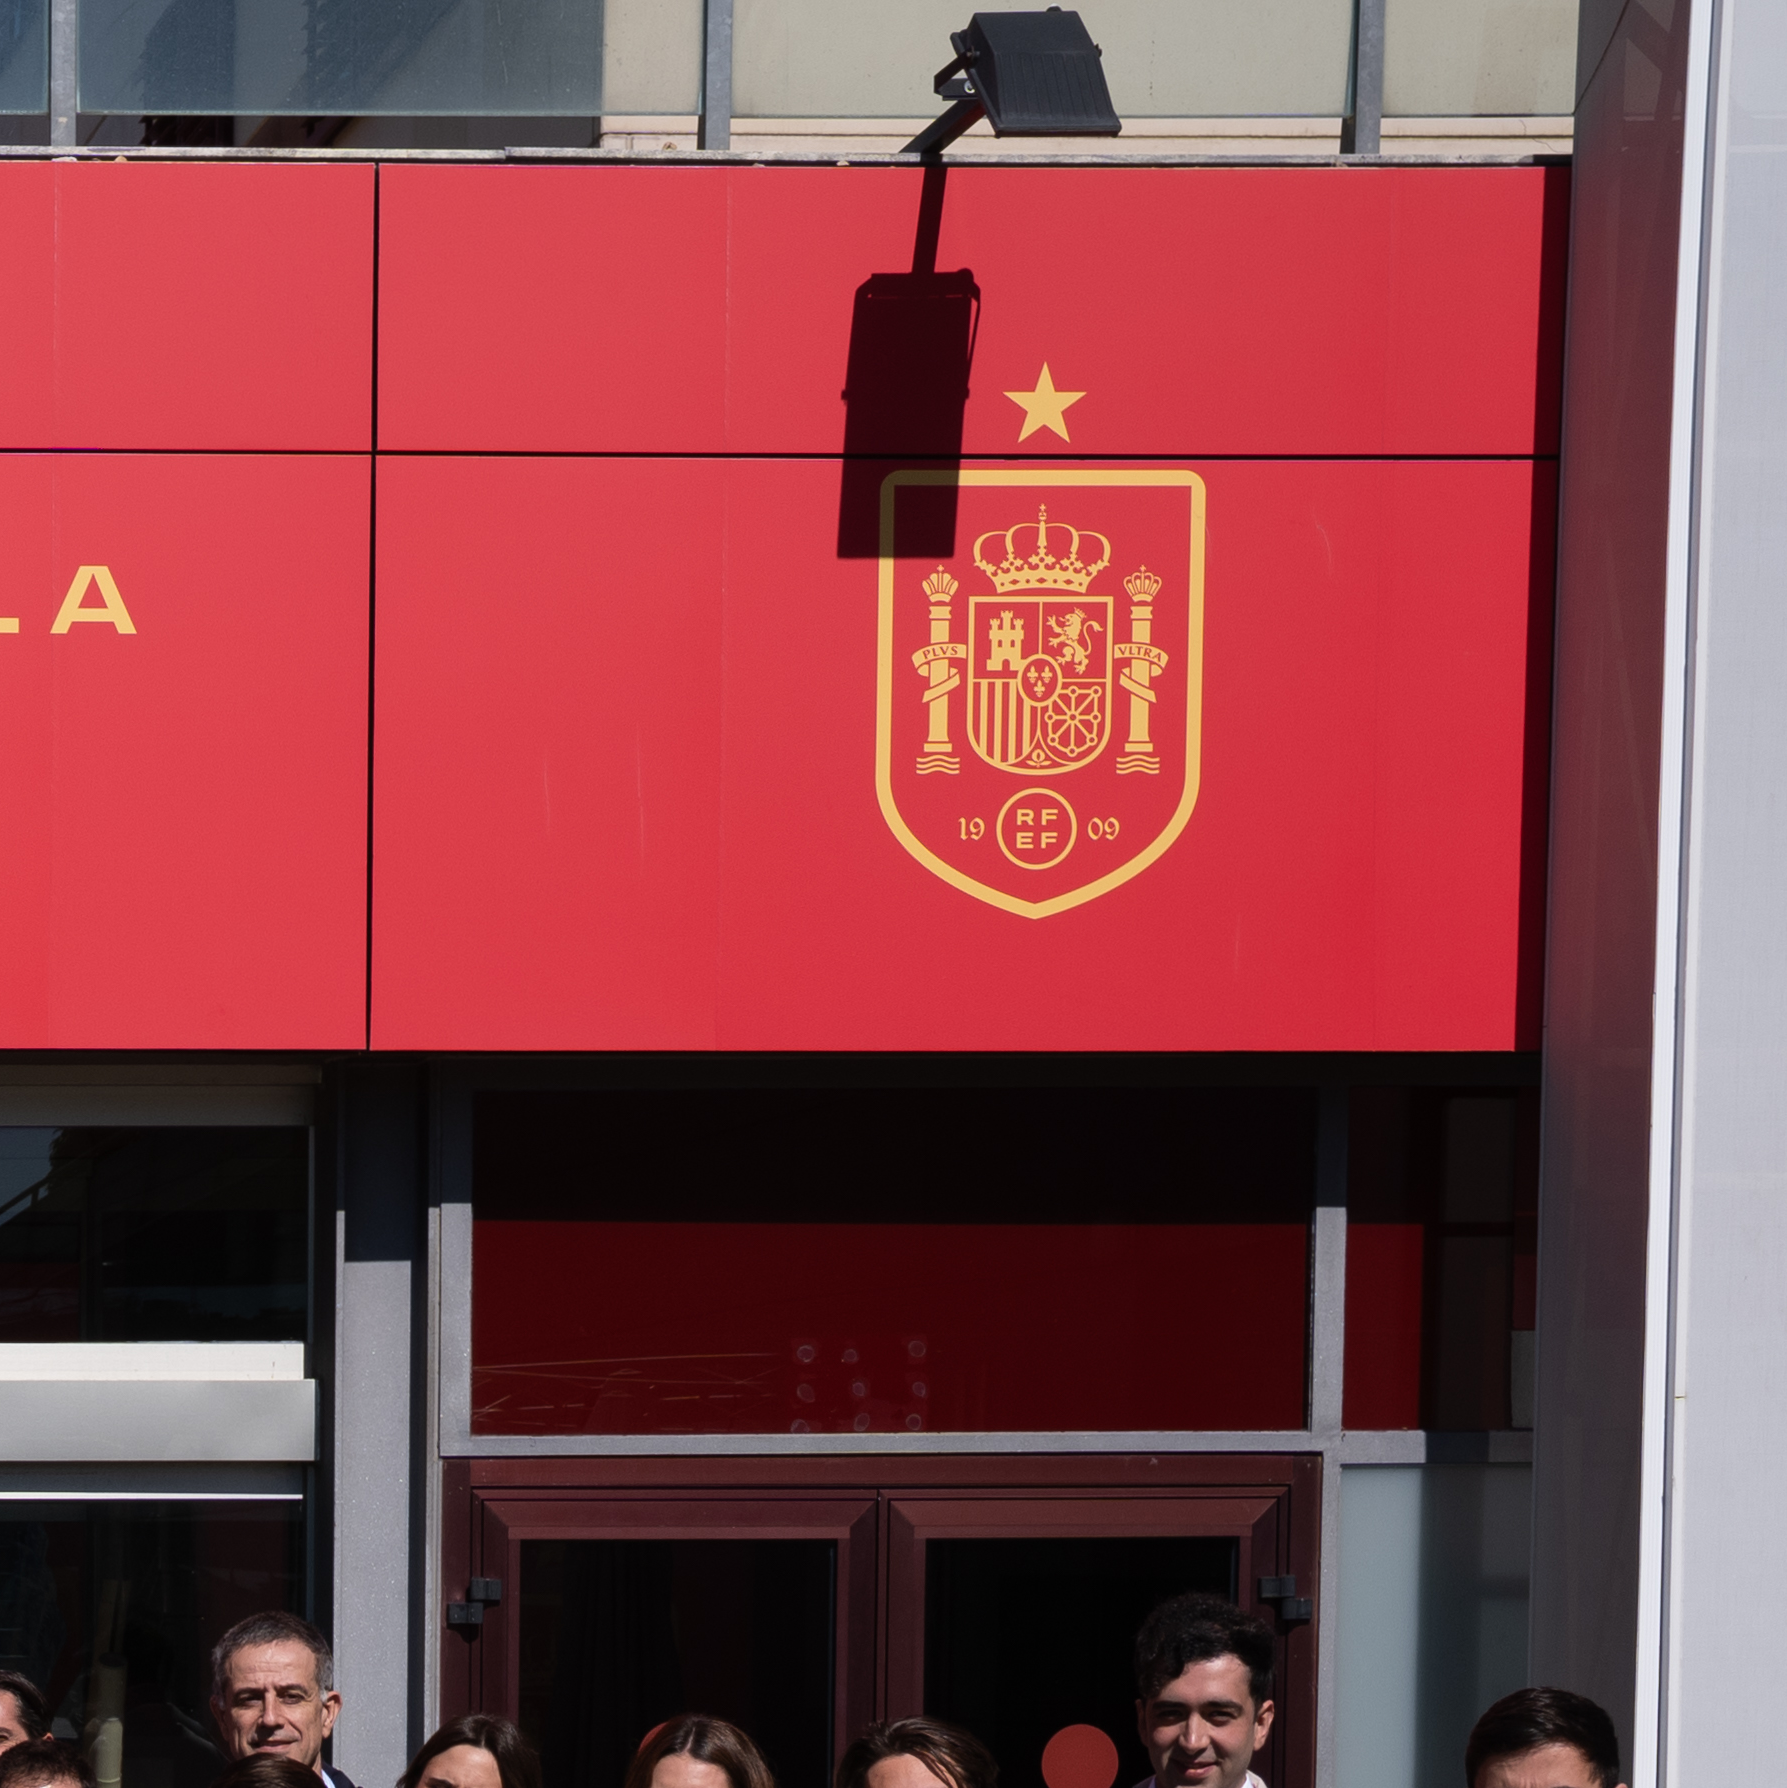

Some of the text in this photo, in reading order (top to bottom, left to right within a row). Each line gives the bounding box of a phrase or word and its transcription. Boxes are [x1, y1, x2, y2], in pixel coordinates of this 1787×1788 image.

[922, 645, 958, 660] PLVS
[1117, 645, 1162, 663] VLTRA
[958, 817, 985, 841] 19
[1087, 817, 1120, 841] 09
